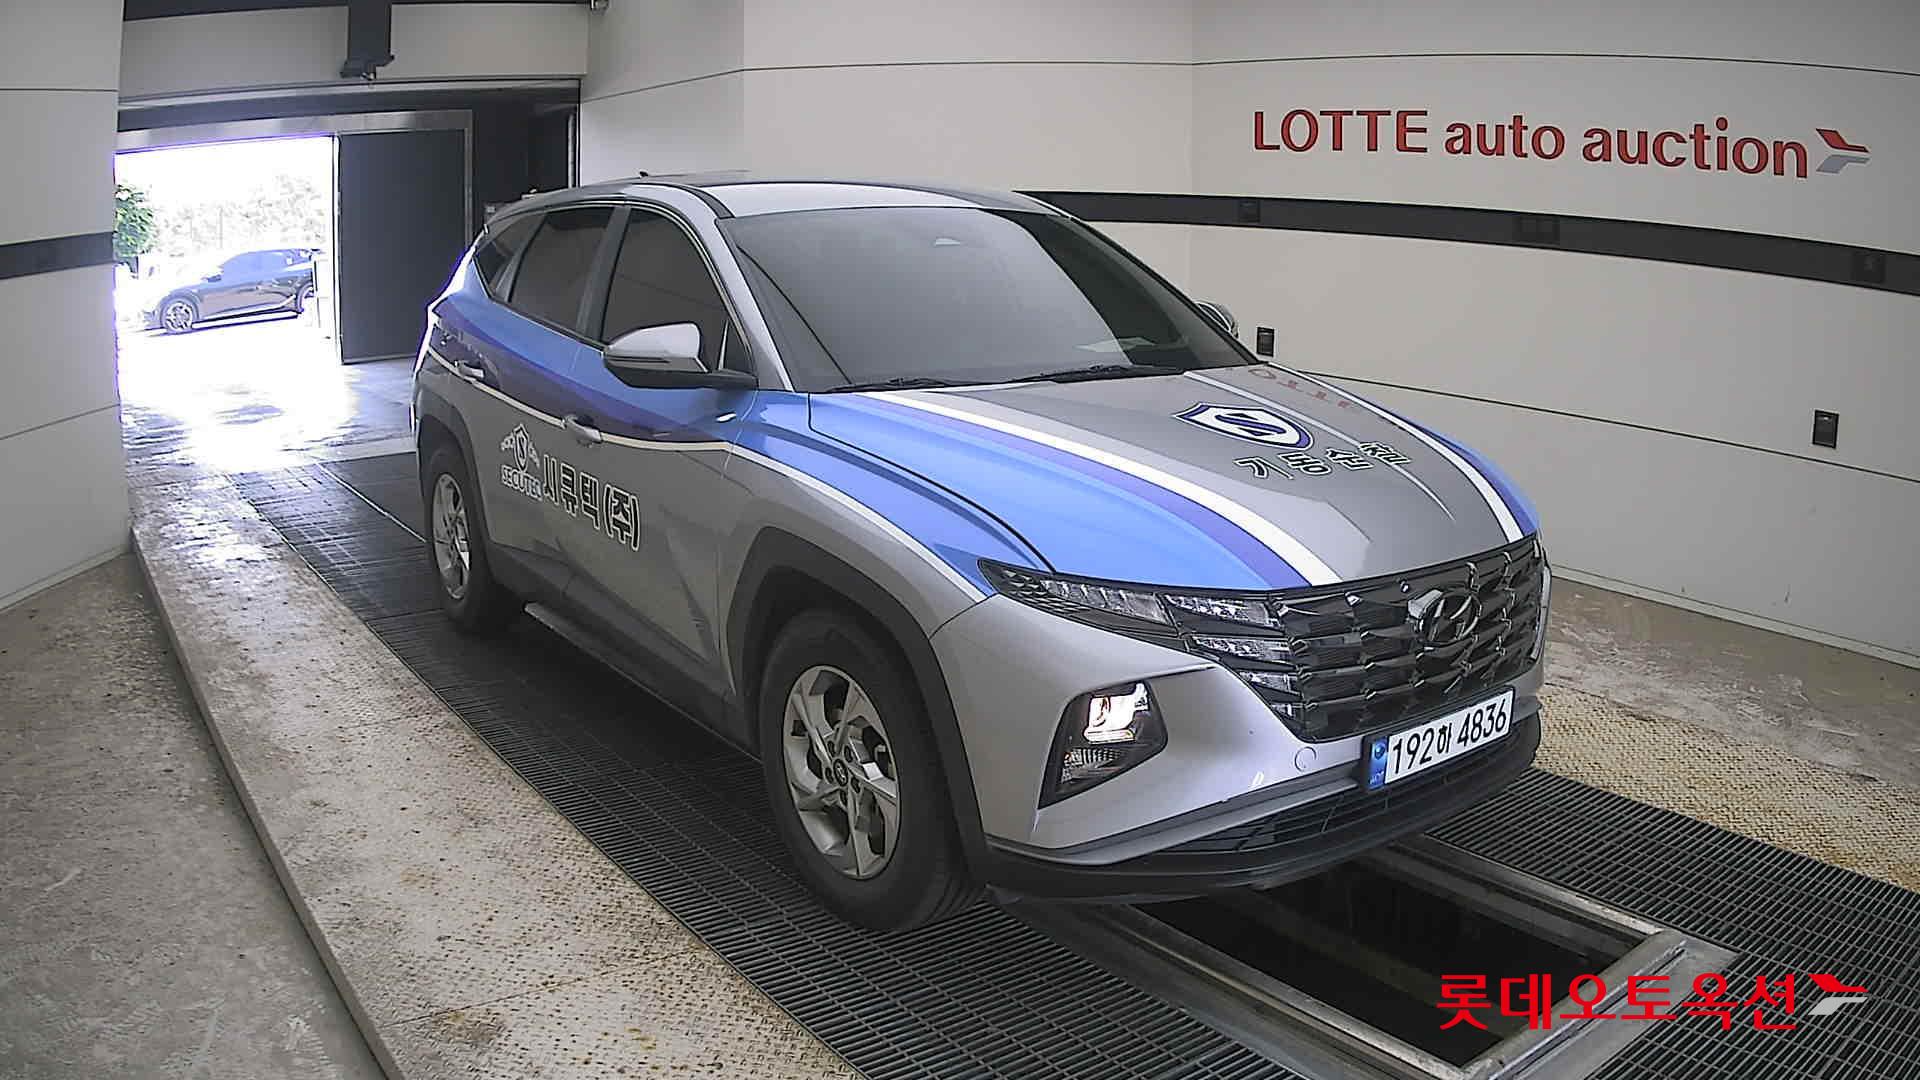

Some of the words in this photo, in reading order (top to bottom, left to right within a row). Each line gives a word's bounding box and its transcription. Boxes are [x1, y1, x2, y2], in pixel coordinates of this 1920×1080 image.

[1253, 110, 1428, 153] LOTTE
[1444, 115, 1566, 159] auto
[1582, 117, 1809, 178] auction
[1392, 721, 1453, 774] 192하
[1457, 698, 1507, 747] 4836
